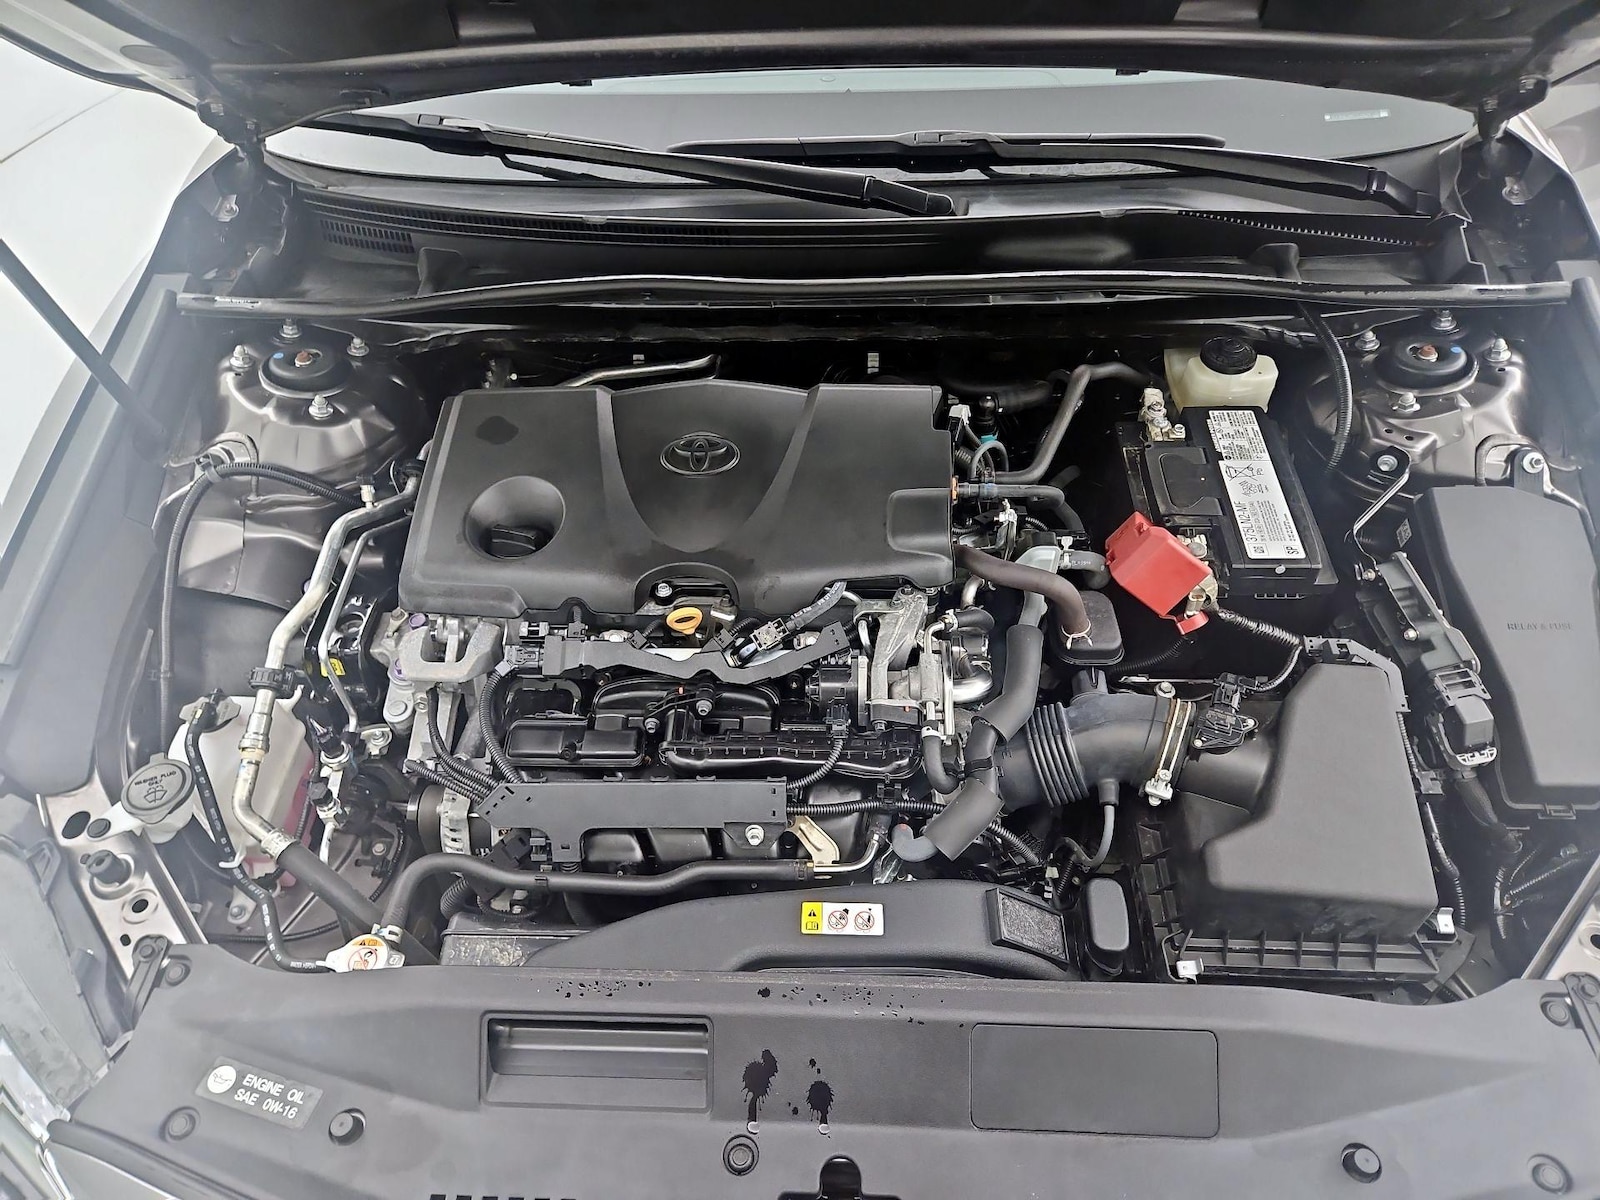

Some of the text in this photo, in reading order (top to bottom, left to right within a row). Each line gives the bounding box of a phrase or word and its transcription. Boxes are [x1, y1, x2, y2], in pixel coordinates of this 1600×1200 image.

[1287, 546, 1300, 555] SP
[1507, 622, 1538, 631] RELAY
[242, 1074, 304, 1104] ENGINE OIL
[234, 1089, 298, 1119] SAE 0W-16
